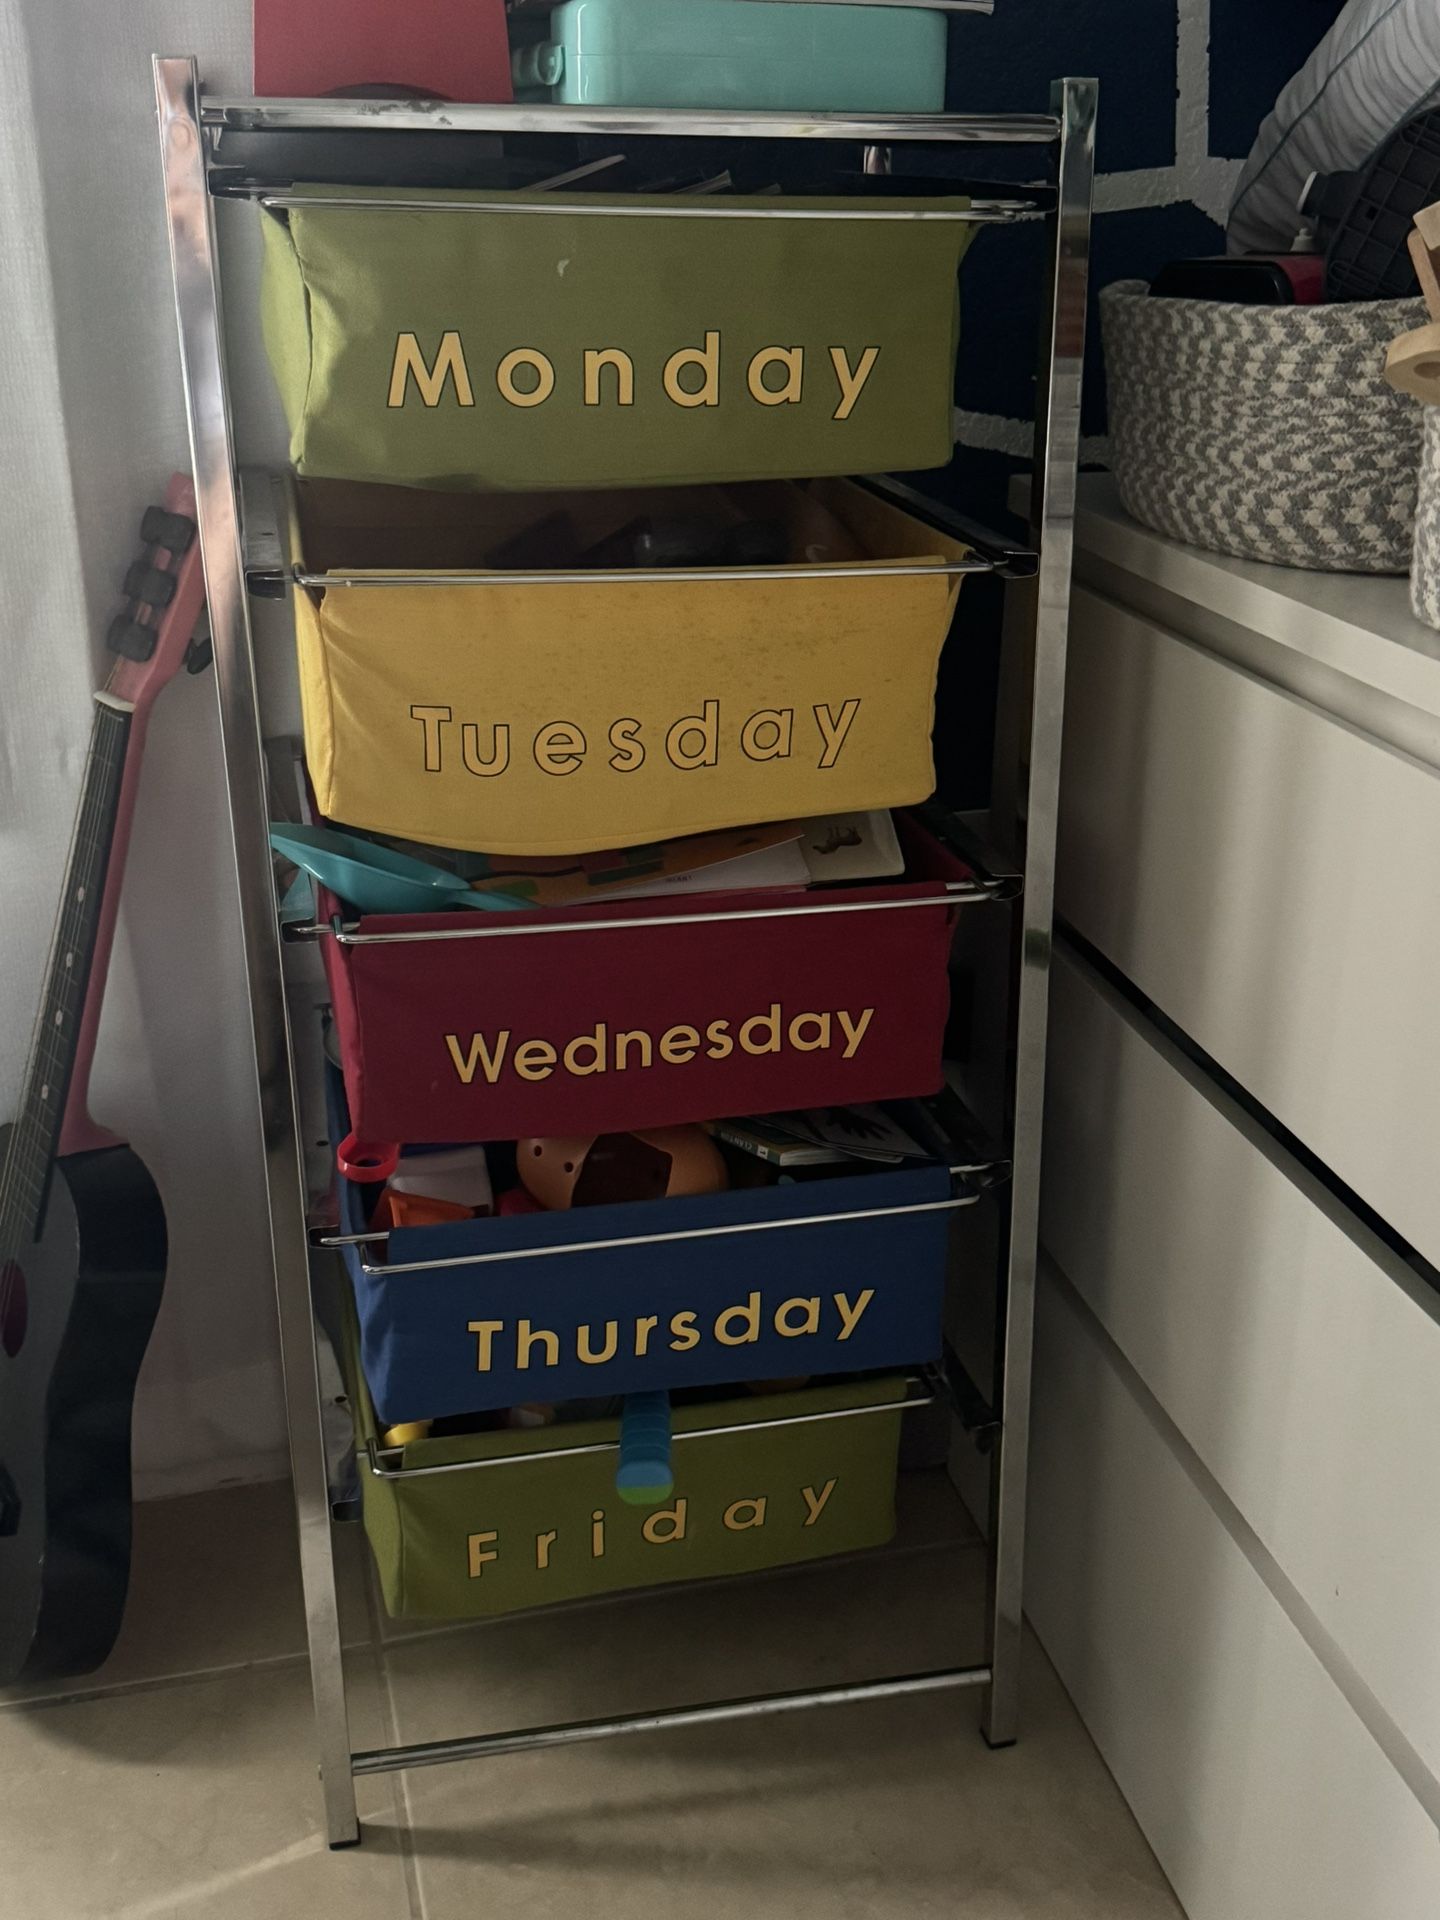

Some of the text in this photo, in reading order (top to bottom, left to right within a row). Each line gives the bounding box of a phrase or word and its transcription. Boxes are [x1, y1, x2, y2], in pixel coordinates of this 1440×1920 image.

[387, 330, 880, 421] Monday
[411, 698, 862, 778] Tuesday
[445, 1003, 875, 1084] Wednesday
[467, 1288, 876, 1373] Thursday
[467, 1478, 838, 1578] Friday
